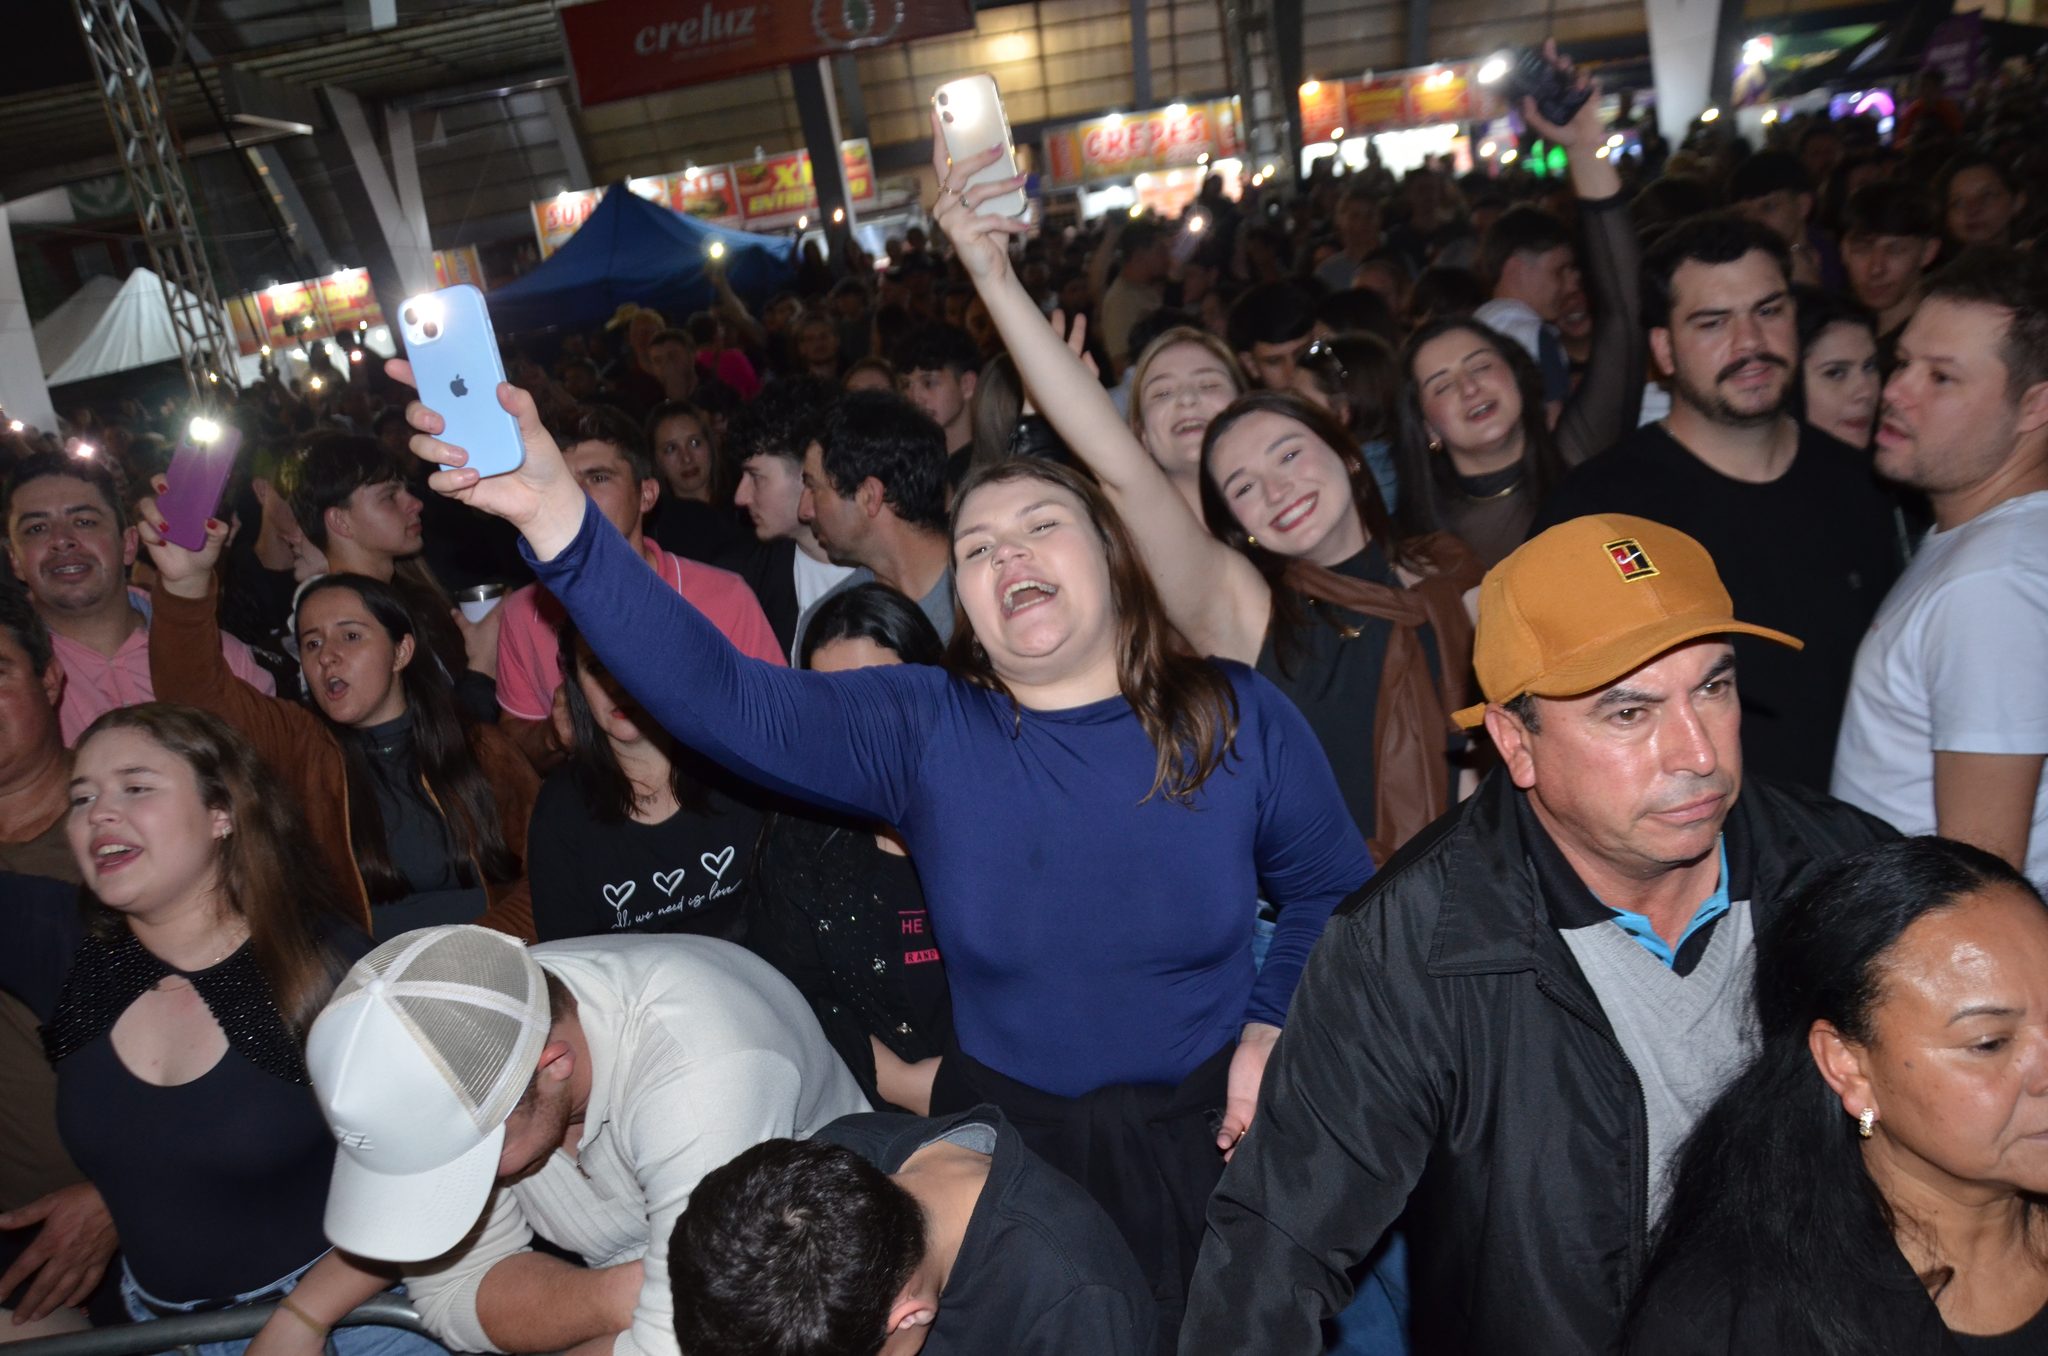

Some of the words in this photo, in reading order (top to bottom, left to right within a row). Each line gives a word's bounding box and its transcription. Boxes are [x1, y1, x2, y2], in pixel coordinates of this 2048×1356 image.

[634, 3, 756, 56] creluz
[635, 910, 654, 923] we
[657, 896, 684, 915] need
[687, 895, 705, 908] is
[709, 879, 742, 900] love
[901, 918, 923, 934] HE
[906, 950, 937, 962] RAND
